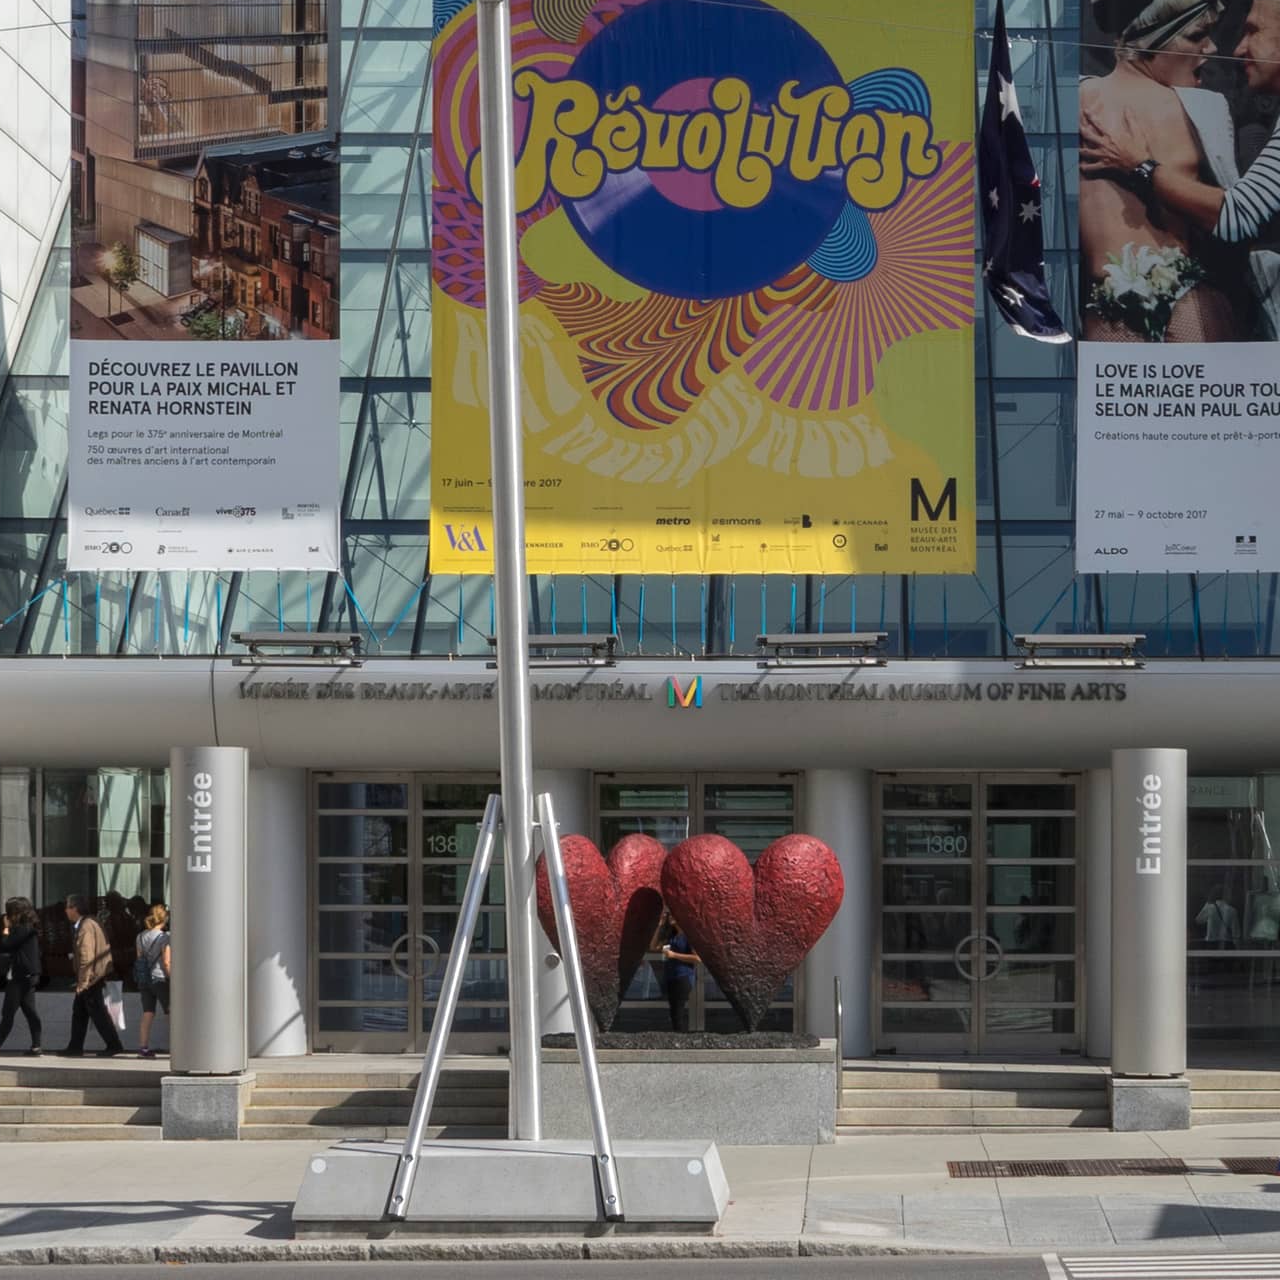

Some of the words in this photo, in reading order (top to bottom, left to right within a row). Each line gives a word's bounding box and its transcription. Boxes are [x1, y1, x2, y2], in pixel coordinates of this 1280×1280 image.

[88, 358, 191, 377] DÉCOUVREZ
[196, 362, 215, 377] LE
[220, 362, 299, 377] PAVILLON
[452, 311, 583, 433] AT
[1095, 364, 1138, 378] LOVE
[1143, 364, 1157, 378] IS
[1162, 365, 1205, 379] LOVE
[88, 381, 135, 396] POUR
[141, 381, 161, 396] LA
[167, 381, 202, 396] PAIX
[207, 381, 270, 396] MICHAL
[276, 381, 296, 396] ET
[1095, 383, 1114, 397] LE
[1120, 383, 1194, 398] MARIAGE
[1199, 383, 1246, 398] POUR
[88, 401, 151, 415] RENATA
[157, 401, 252, 416] HORNSTEIN
[1095, 402, 1149, 417] SELON
[1153, 403, 1196, 417] JEAN
[1201, 403, 1242, 417] PAUL
[87, 430, 109, 440] Legs
[111, 432, 133, 440] pour
[136, 430, 145, 438] le
[169, 430, 225, 439] anniversaire
[227, 430, 240, 439] de
[242, 429, 283, 439] Montréal
[1094, 431, 1140, 441] Créations
[1142, 431, 1169, 441] haute
[1171, 431, 1208, 441] couture
[1210, 431, 1221, 441] et
[87, 445, 105, 455] 750
[170, 445, 230, 455] international
[747, 410, 897, 478] MODE
[87, 457, 104, 466] des
[106, 456, 142, 466] maîtres
[144, 457, 180, 466] anciens
[182, 457, 189, 466] à
[211, 457, 276, 468] contemporain
[442, 478, 452, 487] 17
[454, 478, 473, 488] juin
[539, 478, 562, 488] 2017
[910, 477, 958, 521] M
[85, 507, 118, 517] Québec
[1094, 510, 1105, 519] 27
[1108, 510, 1125, 519] mai
[1137, 510, 1144, 519] 9
[1146, 510, 1184, 520] octobre
[1186, 510, 1208, 519] 2017
[655, 516, 691, 526] metro
[910, 525, 939, 534] MUSÉE
[443, 523, 488, 552] V&A
[910, 536, 958, 544] BEAUX-ARTS
[910, 544, 958, 553] MONTRÉAL
[1094, 547, 1129, 555] ALDO
[238, 677, 311, 700] MUSÉE
[315, 681, 355, 700] DES
[361, 681, 495, 700] BEAUX-ARTS
[531, 678, 653, 701] MONTRÉAL
[667, 675, 703, 709] M
[720, 683, 761, 701] THE
[765, 682, 884, 701] MONTREAL
[887, 682, 983, 701] MUSEUM
[986, 682, 1015, 701] OF
[1017, 682, 1066, 701] FINE
[1069, 682, 1127, 701] ARTS
[186, 772, 213, 873] Entrée
[1135, 773, 1162, 875] Entrée
[926, 835, 968, 853] 1380
